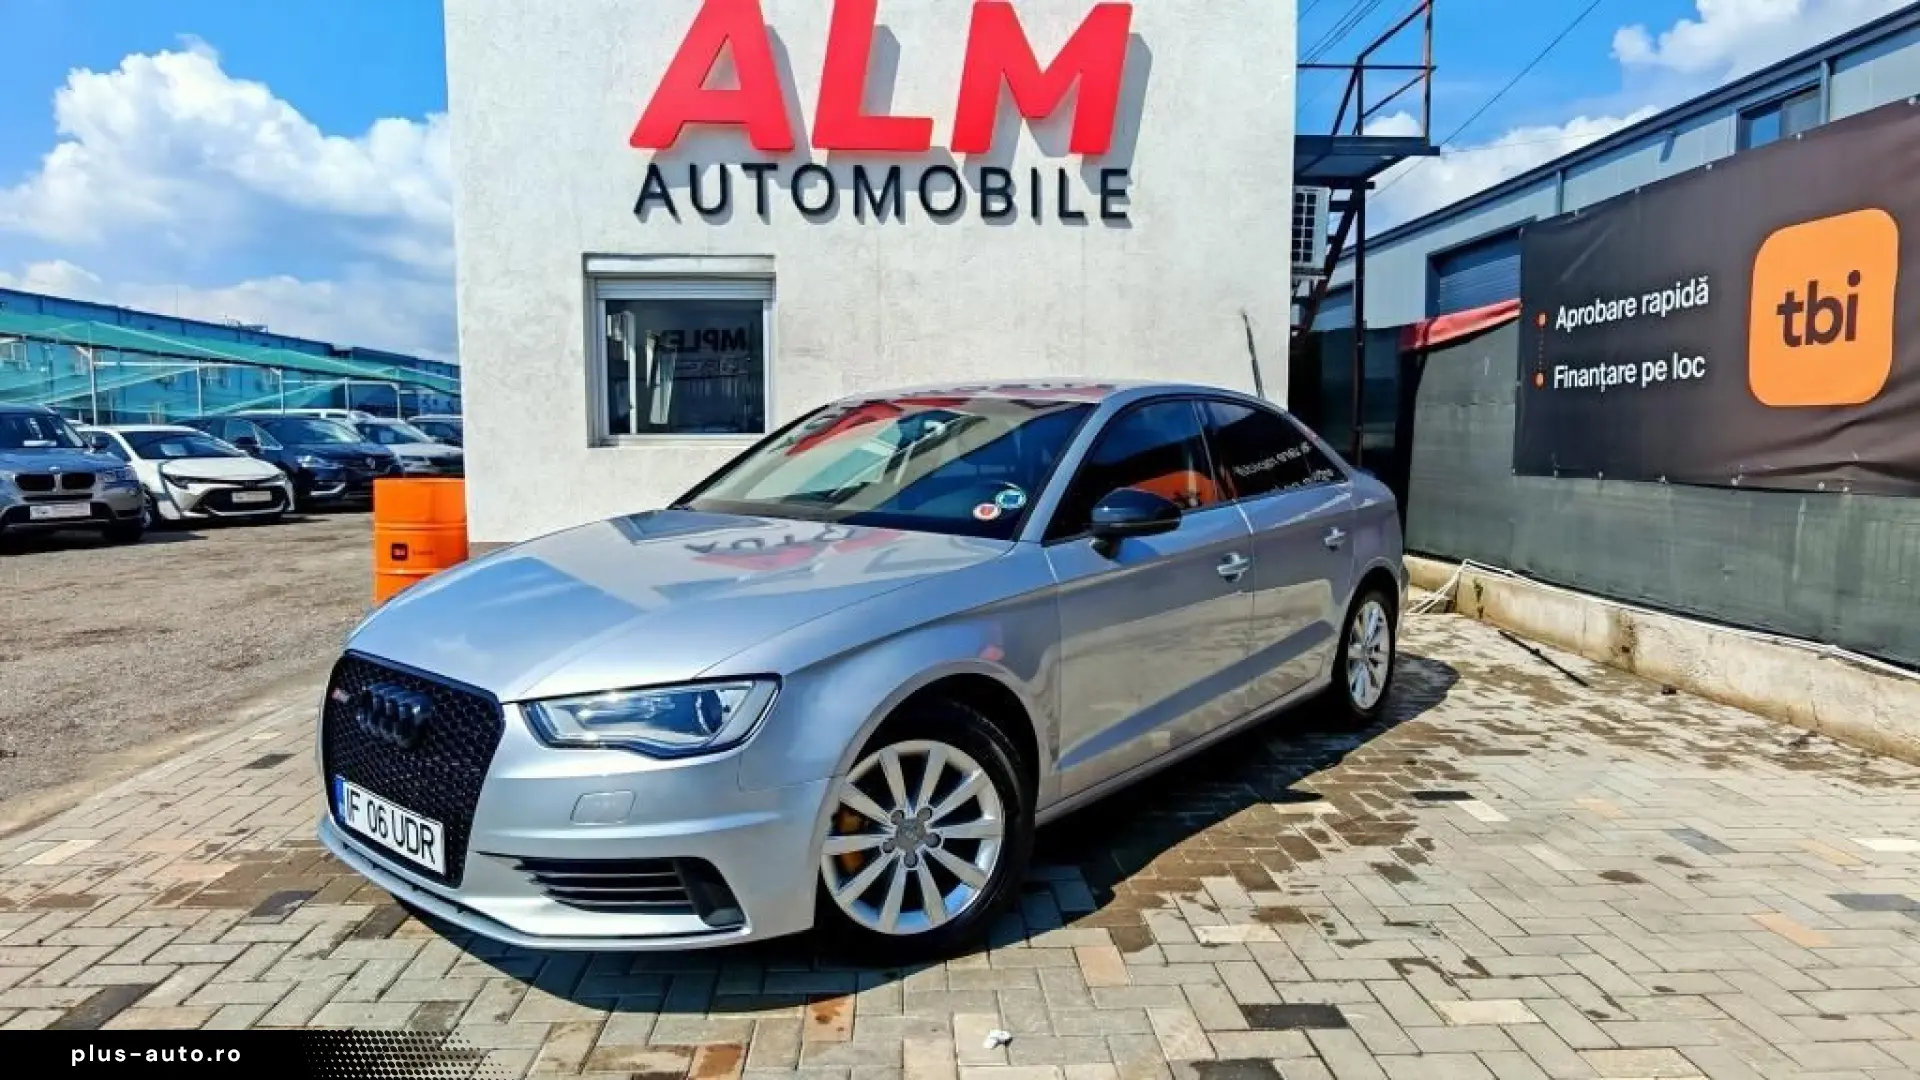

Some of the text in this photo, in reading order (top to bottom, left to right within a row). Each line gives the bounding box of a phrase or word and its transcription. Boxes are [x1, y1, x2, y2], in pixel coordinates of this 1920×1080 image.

[629, 0, 1133, 155] ALM
[633, 162, 1131, 222] AUTOMOBILE
[1555, 275, 1709, 333] Aprobare rapidă
[1776, 269, 1861, 348] tbi
[1553, 351, 1706, 393] Finanțare pe loc
[367, 800, 389, 839] 06
[391, 809, 436, 866] UDR
